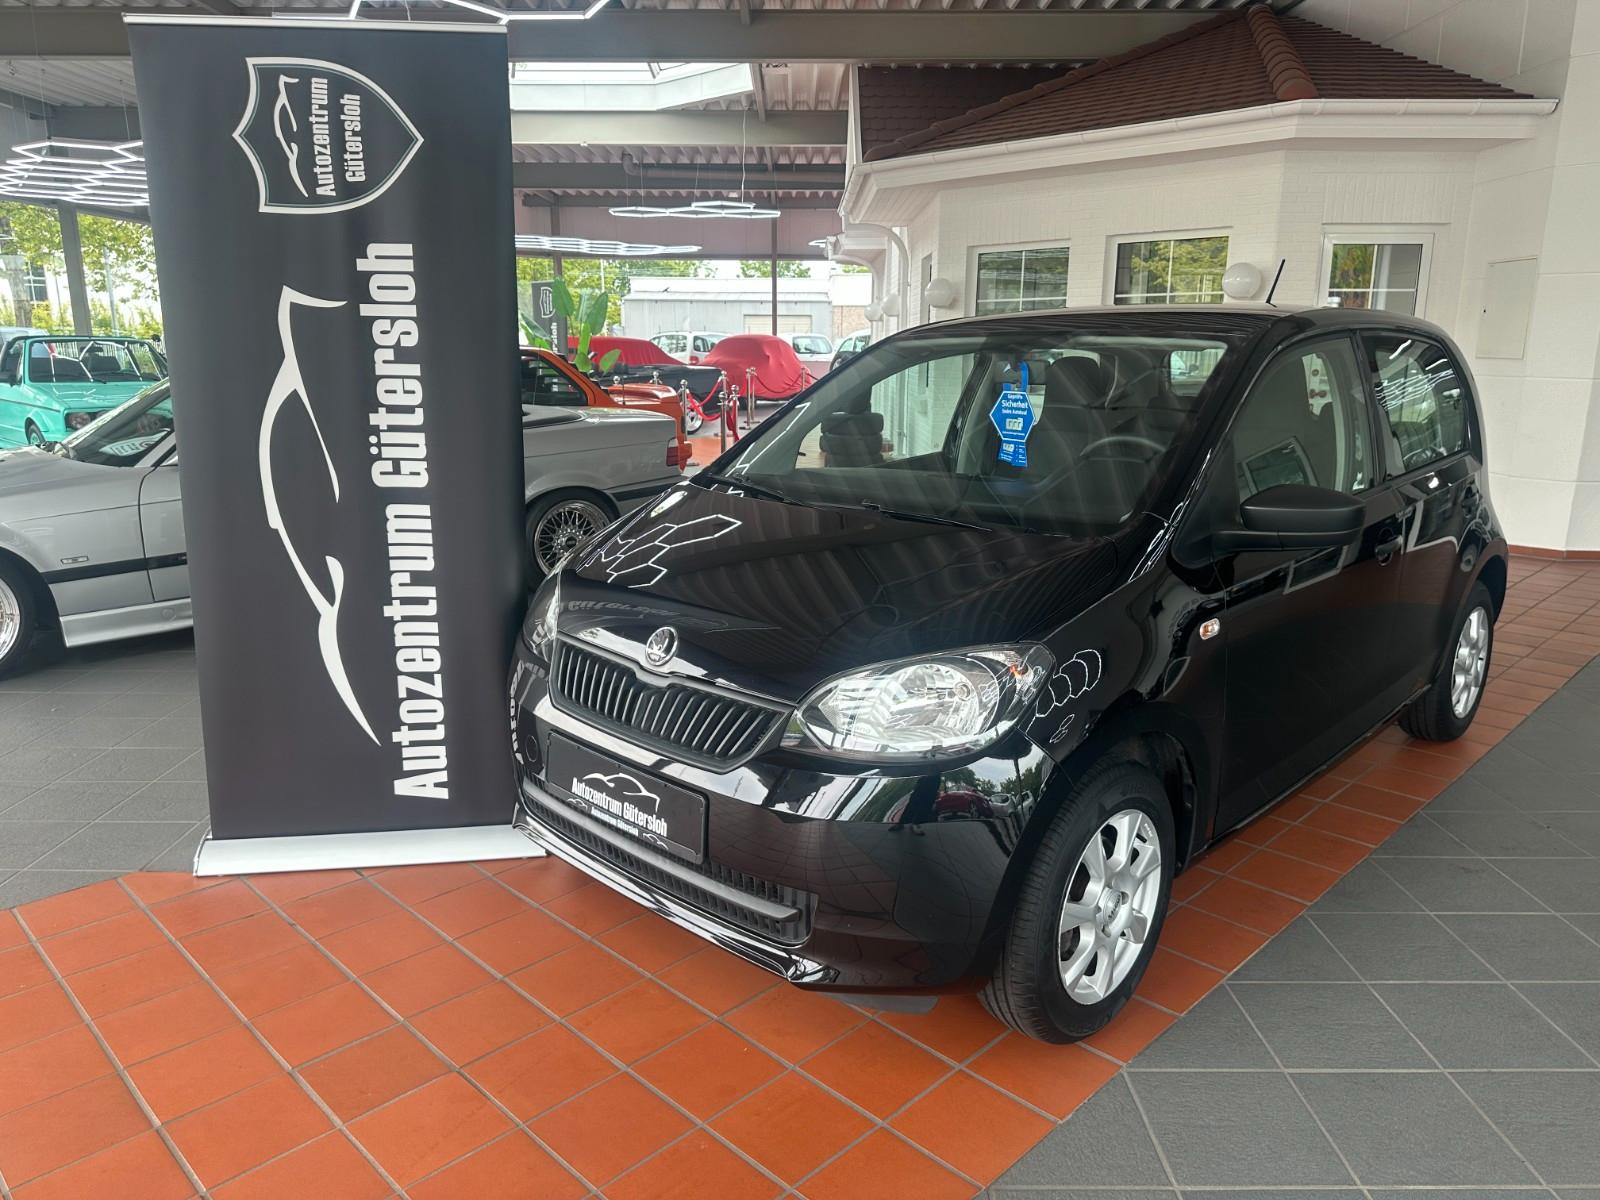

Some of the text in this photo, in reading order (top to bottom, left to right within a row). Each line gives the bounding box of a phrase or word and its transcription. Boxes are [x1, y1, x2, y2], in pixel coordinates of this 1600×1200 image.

[309, 77, 336, 196] Autozentrum
[339, 93, 366, 182] Gütersloh
[356, 242, 449, 799] Autozentrum Gütersloh
[571, 777, 668, 837] Autozentrum Gütersloh
